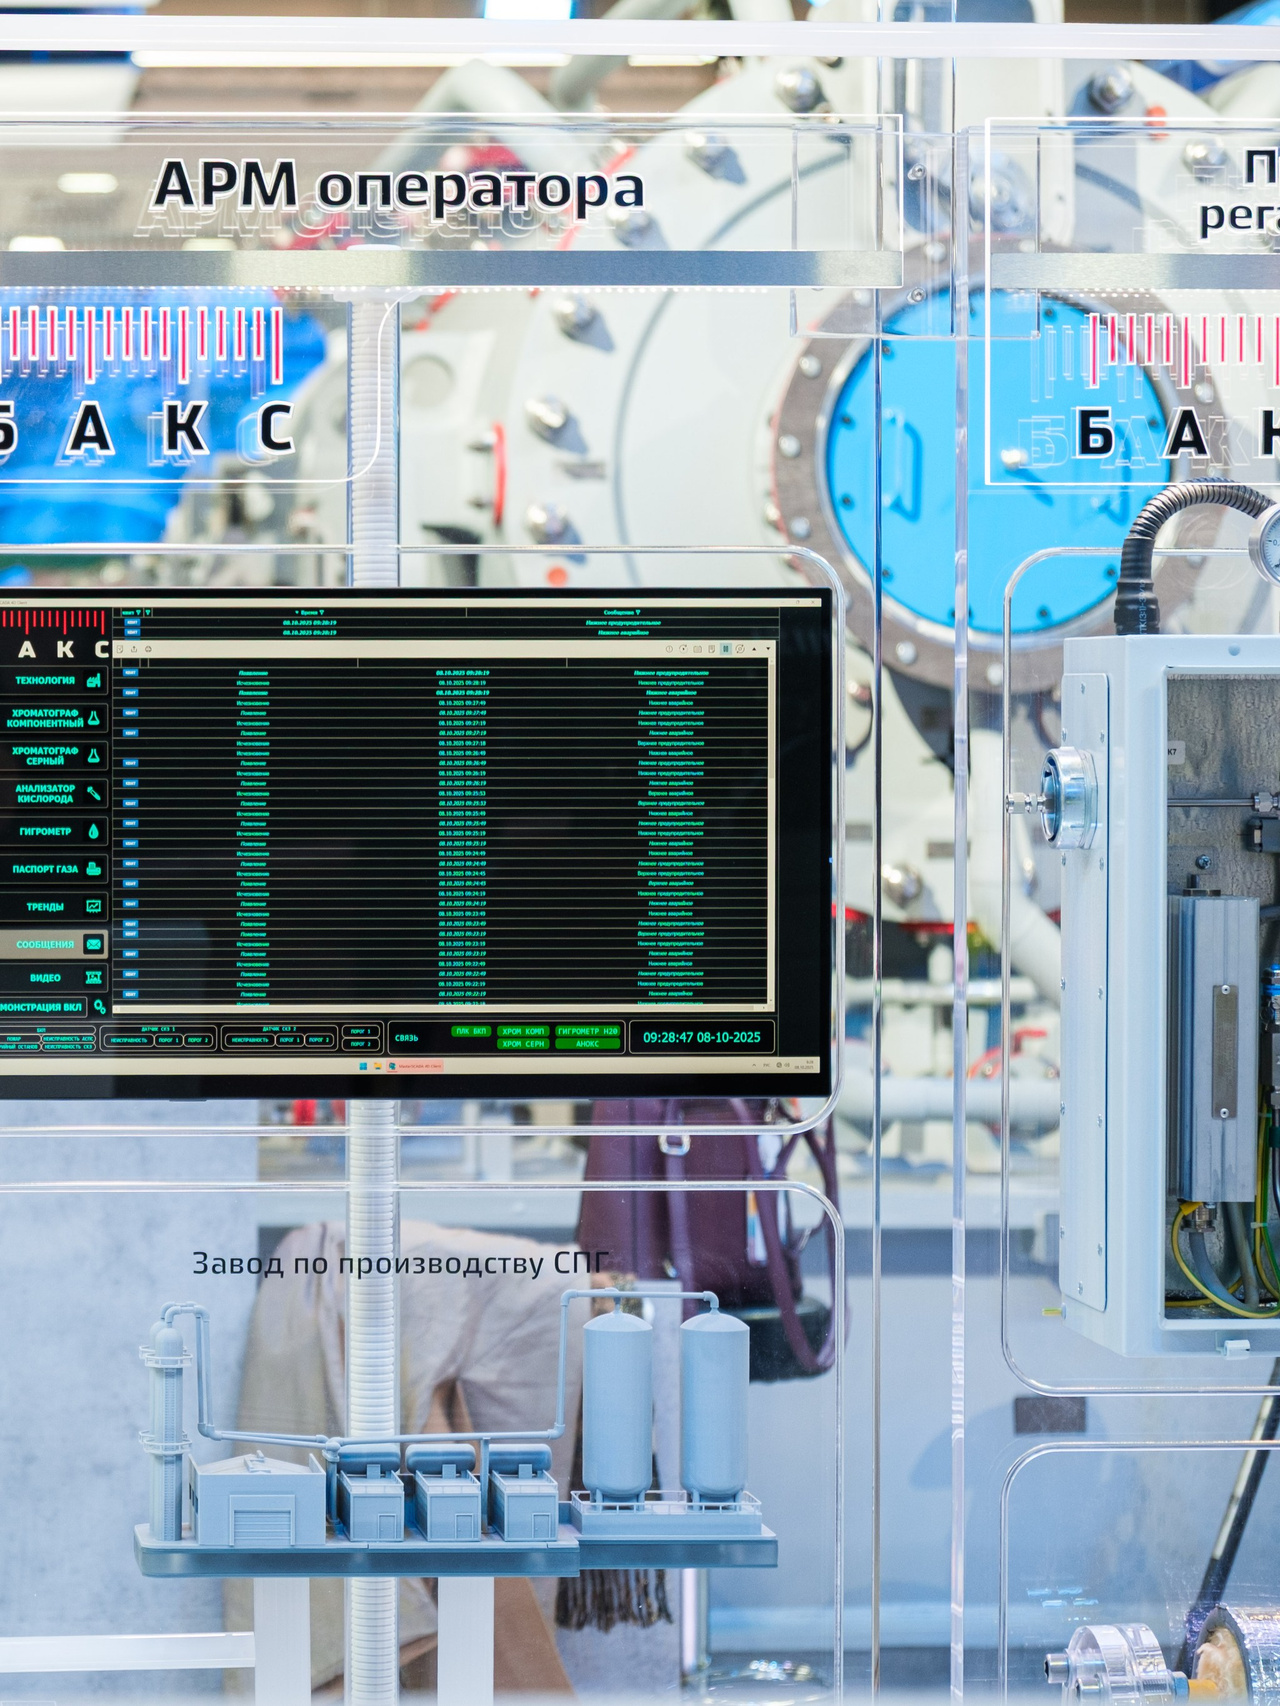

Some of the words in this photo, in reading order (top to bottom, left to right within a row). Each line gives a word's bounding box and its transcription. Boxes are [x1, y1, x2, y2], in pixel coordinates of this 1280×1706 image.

[1245, 147, 1280, 186] П
[151, 158, 298, 211] АРМ
[317, 167, 646, 222] оператора
[15, 676, 75, 684] ТЕХНОЛОГИЯ
[12, 709, 79, 717] ХРОМАТОГРАФ
[7, 718, 84, 727] КОМПОНЕНТНЫЙ
[12, 747, 79, 756] ХРОМАТОГРАФ
[26, 756, 64, 765] СЕРНЫЙ
[16, 784, 75, 792] АНАЛИЗАТОР
[18, 795, 73, 804] КИСЛОРОДА
[20, 827, 71, 835] ГИГРОМЕТР
[13, 865, 53, 873] ПАСПОРТ
[56, 865, 78, 873] ГАЗА
[27, 903, 64, 912] ТРЕНДЫ
[16, 940, 74, 950] СООБЩЕНИЯ
[30, 973, 61, 983] ВИДЕО
[63, 1003, 82, 1011] ВКЛ
[473, 1027, 487, 1035] БКП
[525, 1027, 545, 1035] КОМП
[558, 1027, 600, 1035] ГИГРОМЕТР
[644, 1032, 693, 1043] 09:28:47
[697, 1032, 760, 1043] 08-10-2025
[503, 1040, 522, 1048] ХРОМ
[525, 1040, 545, 1048] СЕРН
[576, 1040, 599, 1048] АНОКС
[193, 1251, 285, 1278] Завод
[294, 1256, 329, 1275] по
[339, 1256, 545, 1279] производству
[554, 1251, 609, 1275] СПГ
